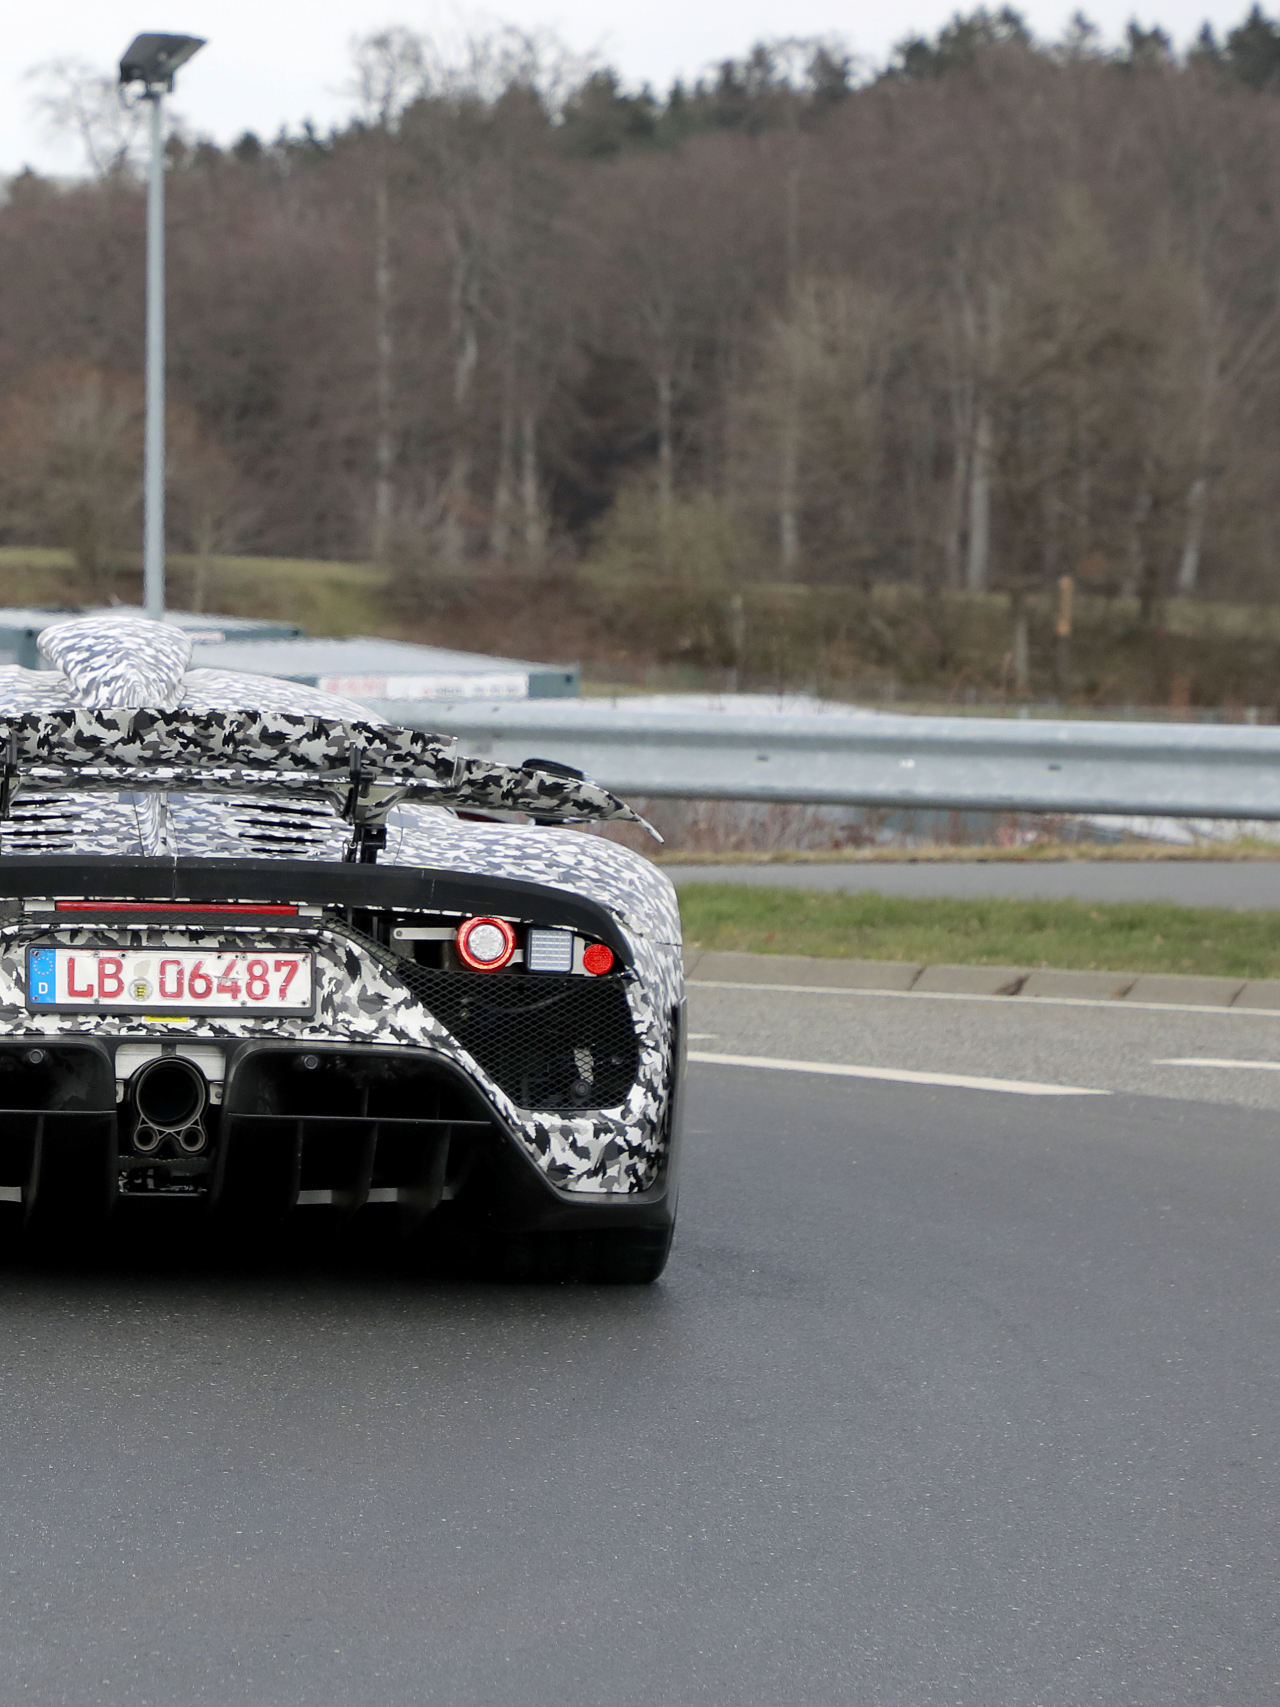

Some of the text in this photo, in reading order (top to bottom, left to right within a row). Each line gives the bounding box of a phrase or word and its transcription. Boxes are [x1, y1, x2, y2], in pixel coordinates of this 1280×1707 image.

[38, 982, 48, 995] D
[67, 956, 300, 1000] LB 06487
